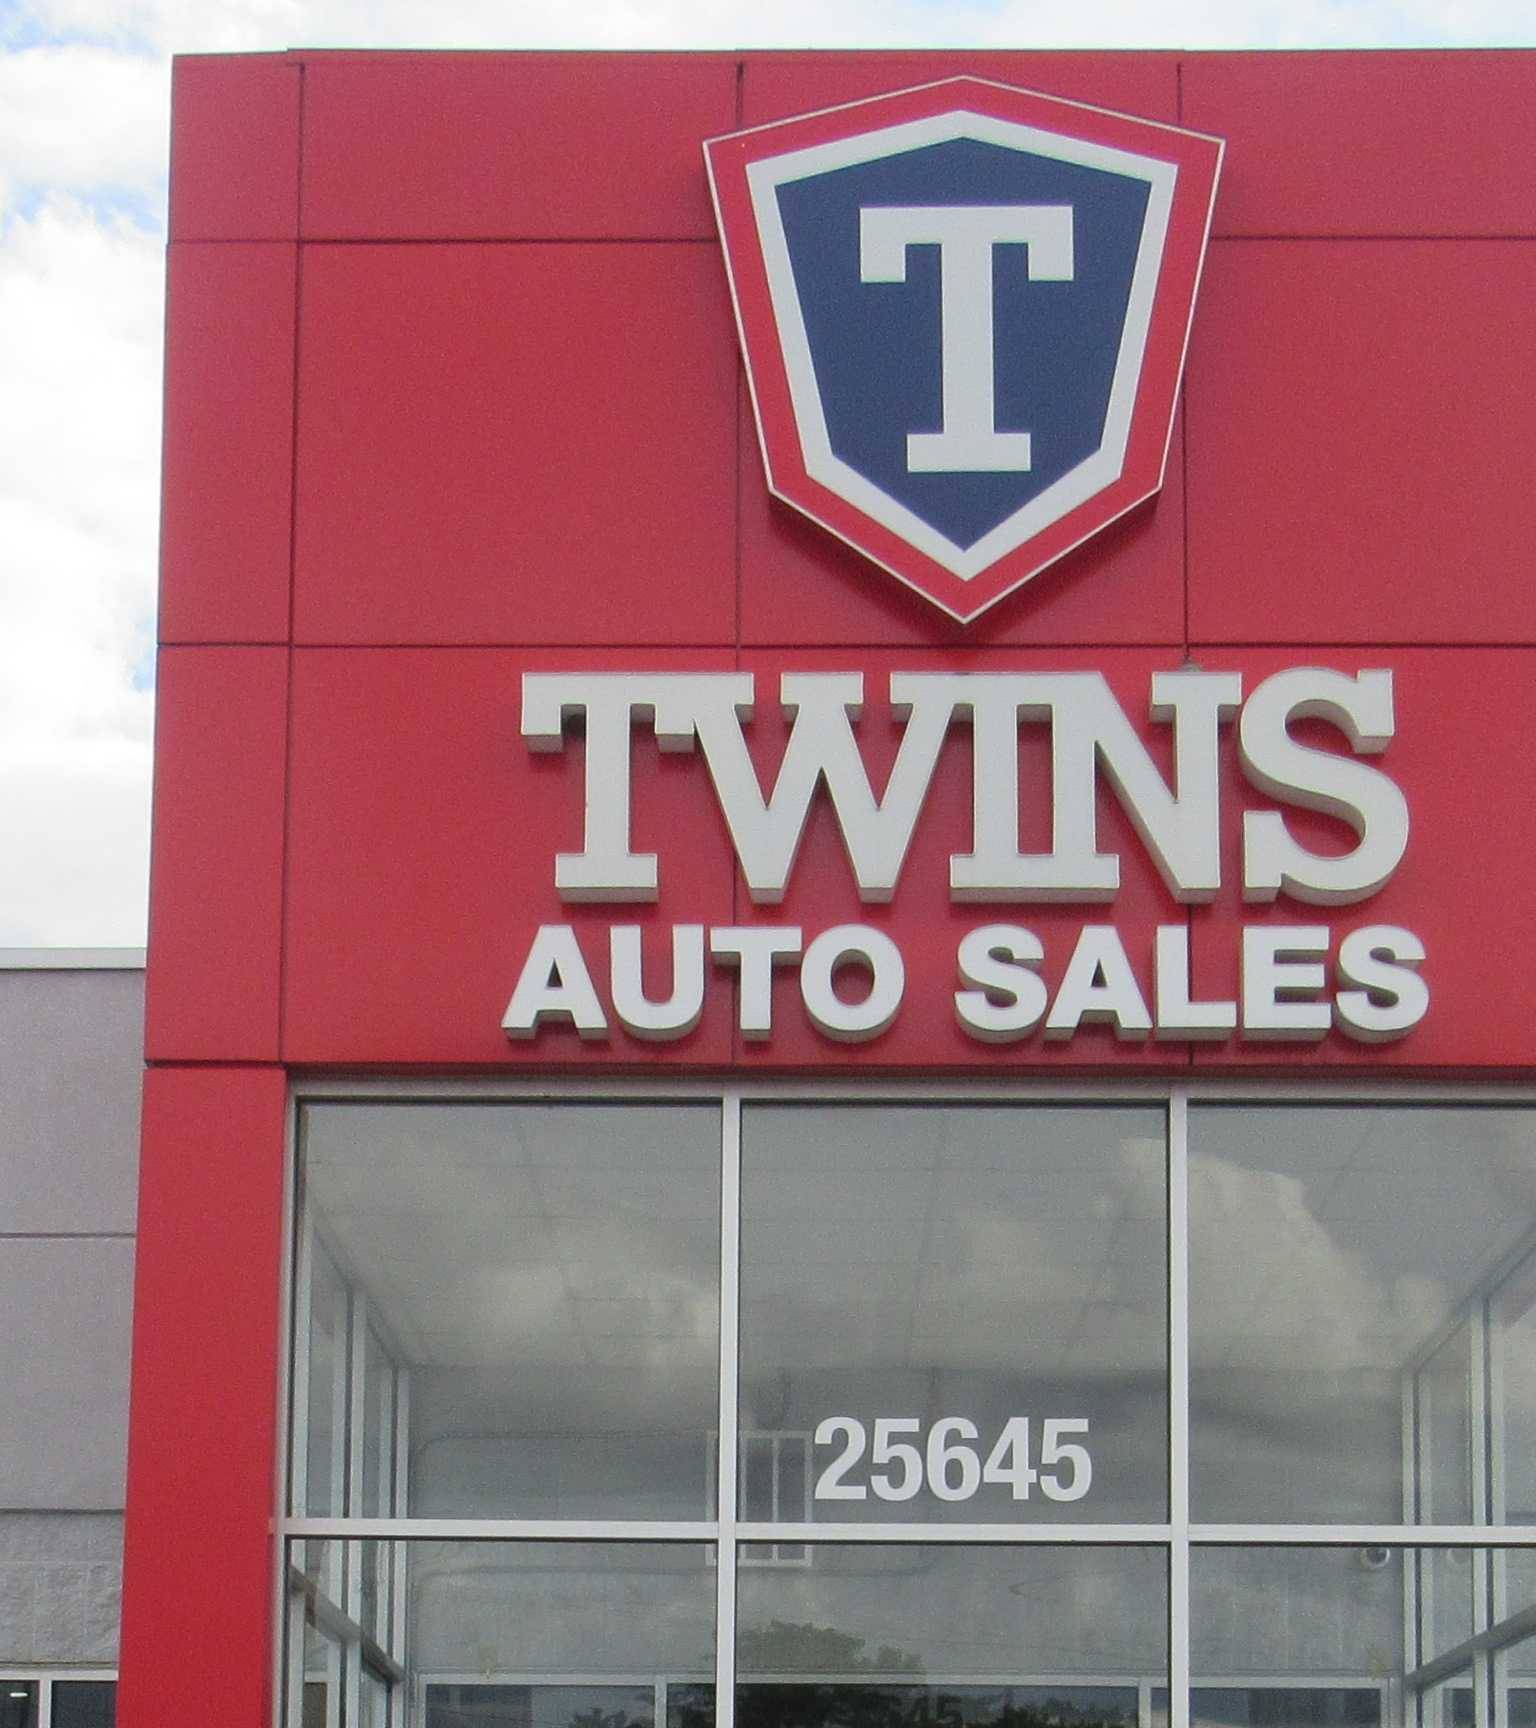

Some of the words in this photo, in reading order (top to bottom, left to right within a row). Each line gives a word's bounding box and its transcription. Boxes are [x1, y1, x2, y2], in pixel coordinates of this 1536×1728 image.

[859, 205, 1074, 473] T
[521, 666, 1410, 906] TWINS
[501, 923, 906, 1043] AUTO
[954, 923, 1430, 1043] SALES
[814, 1416, 1092, 1501] 25645
